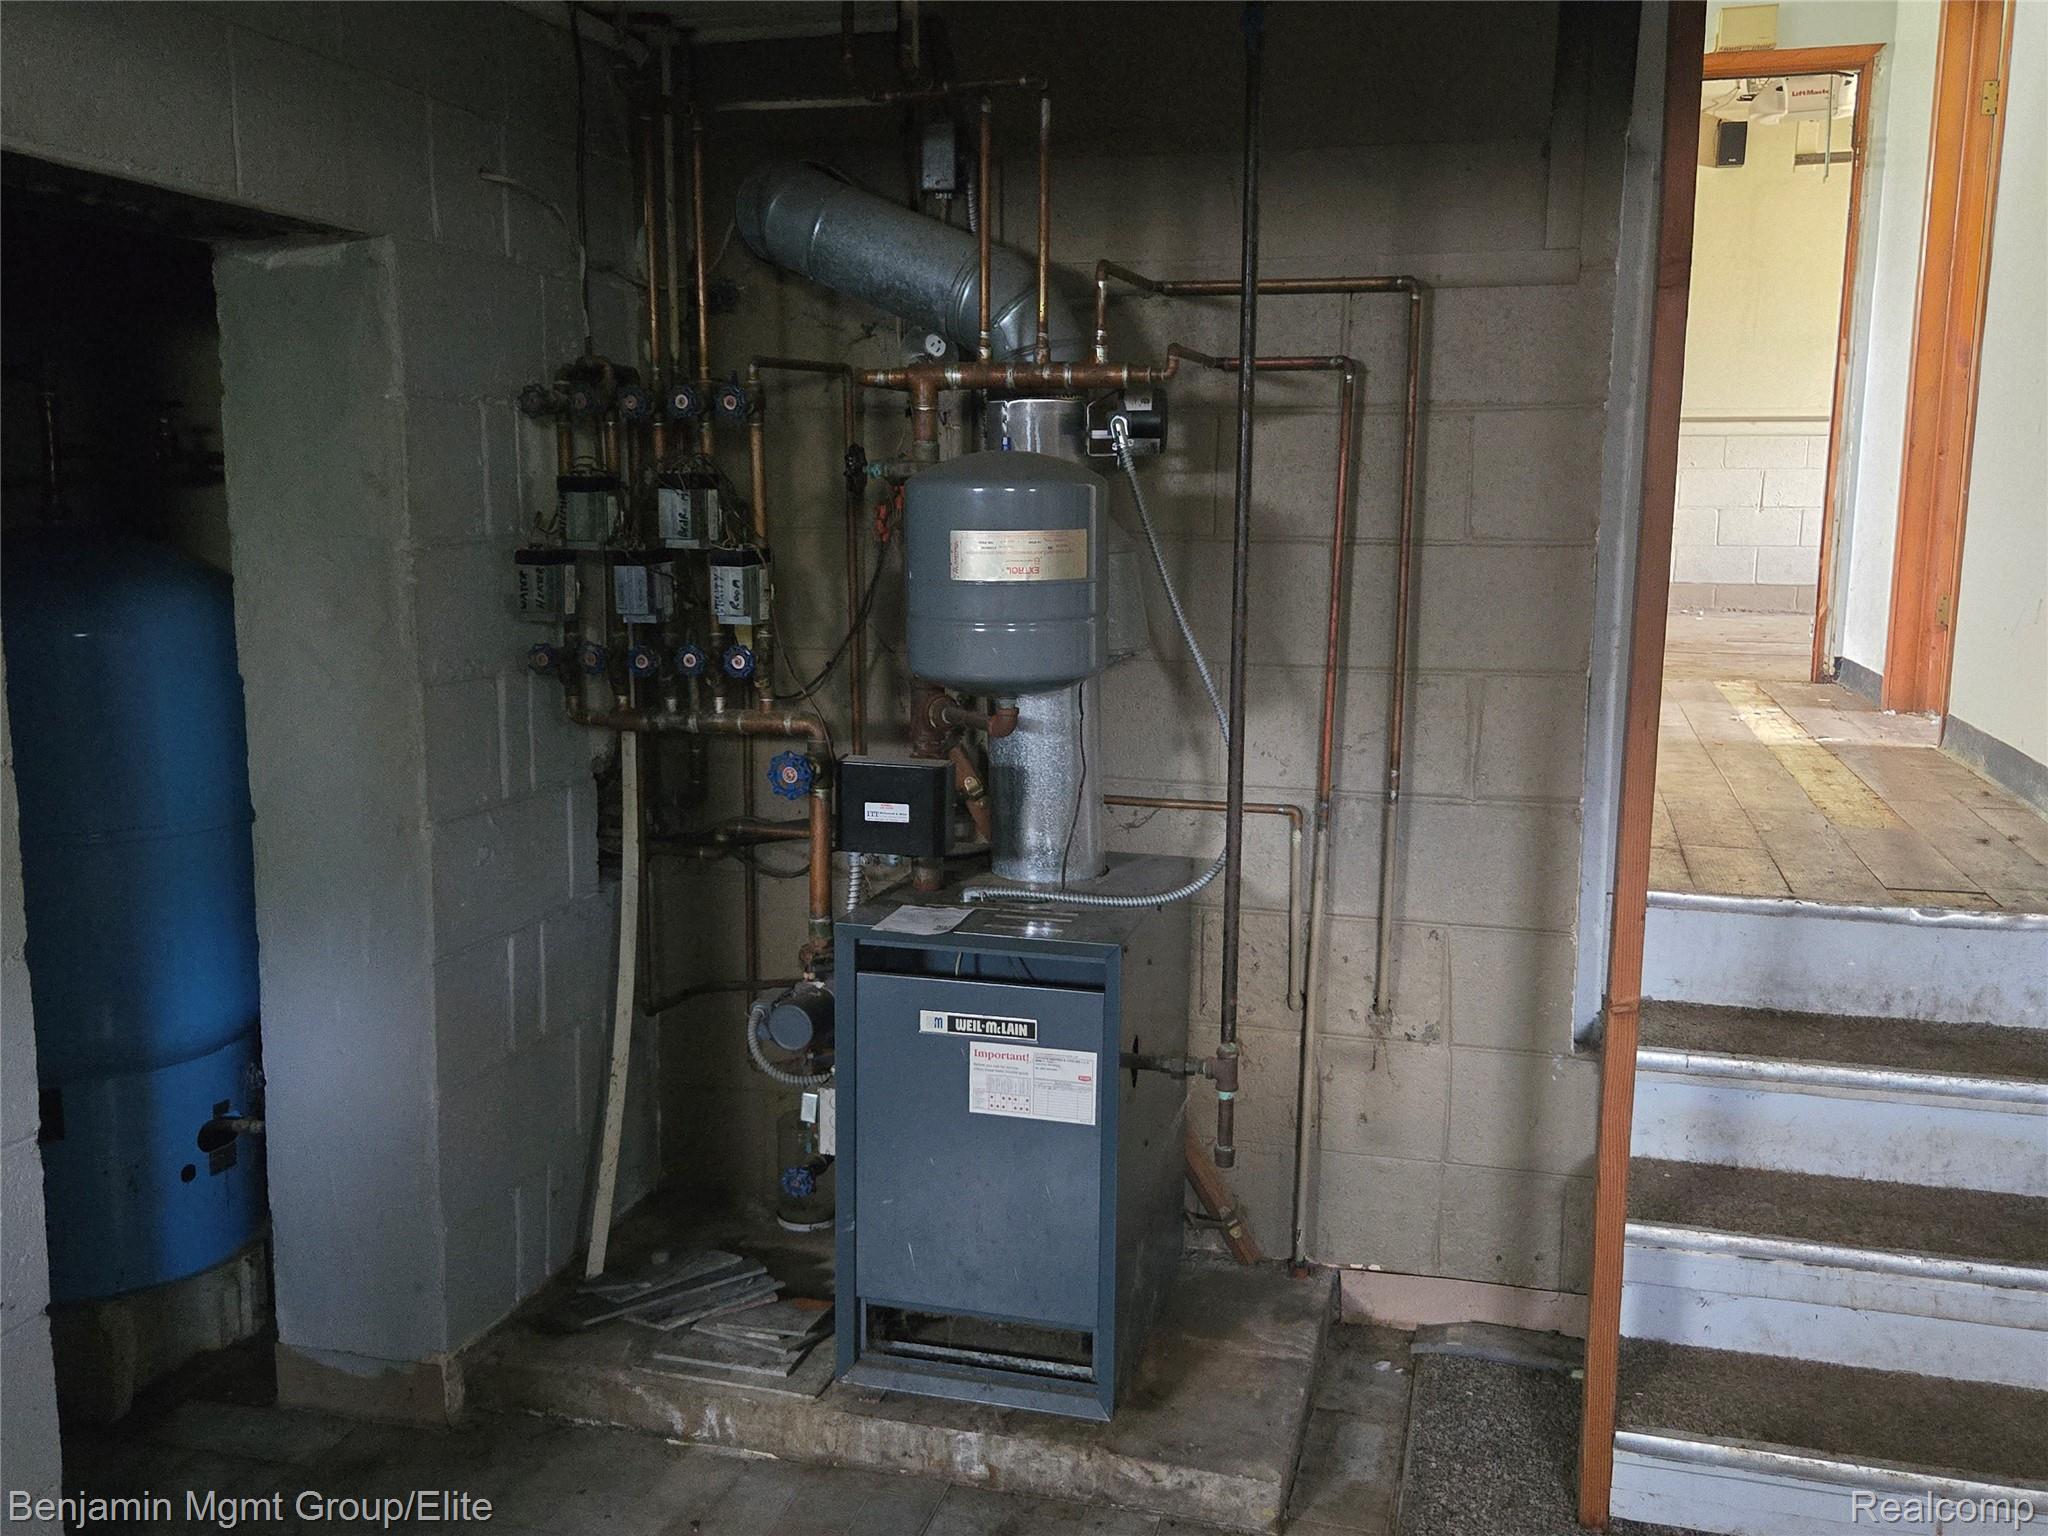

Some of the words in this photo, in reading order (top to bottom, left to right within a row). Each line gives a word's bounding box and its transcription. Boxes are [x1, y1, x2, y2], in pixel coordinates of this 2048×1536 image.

[1791, 89, 1831, 97] LiftMaste
[1008, 566, 1040, 575] EXTROL
[974, 1048, 1030, 1064] Important!
